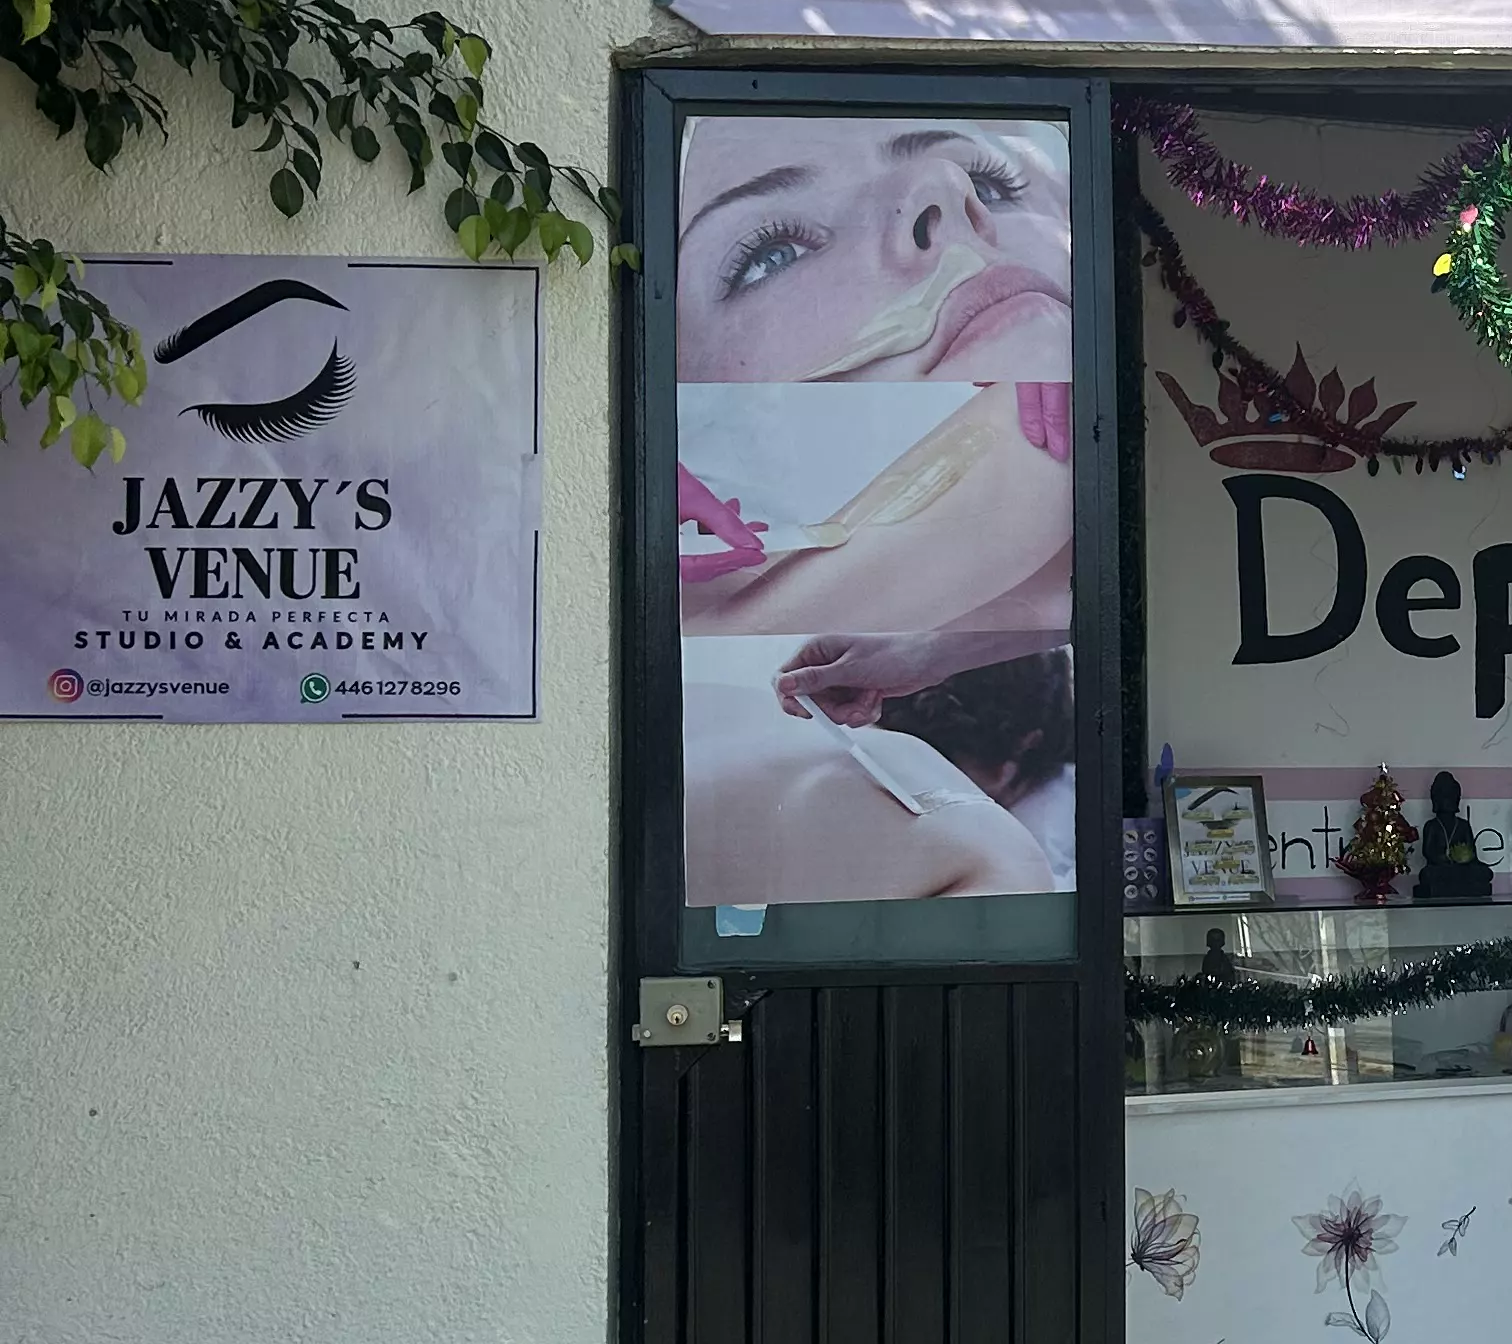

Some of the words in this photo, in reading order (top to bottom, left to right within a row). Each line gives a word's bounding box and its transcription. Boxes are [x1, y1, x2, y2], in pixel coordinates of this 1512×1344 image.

[144, 547, 361, 599] VENUE
[122, 610, 149, 622] TU
[164, 610, 257, 623] MIRADA
[271, 611, 390, 623] PERFECTA
[74, 631, 204, 650] STUDIO
[224, 631, 242, 650] &
[262, 631, 428, 650] ACADEMY
[86, 678, 230, 697] @jazzysvenue
[334, 680, 461, 696] 4461278296
